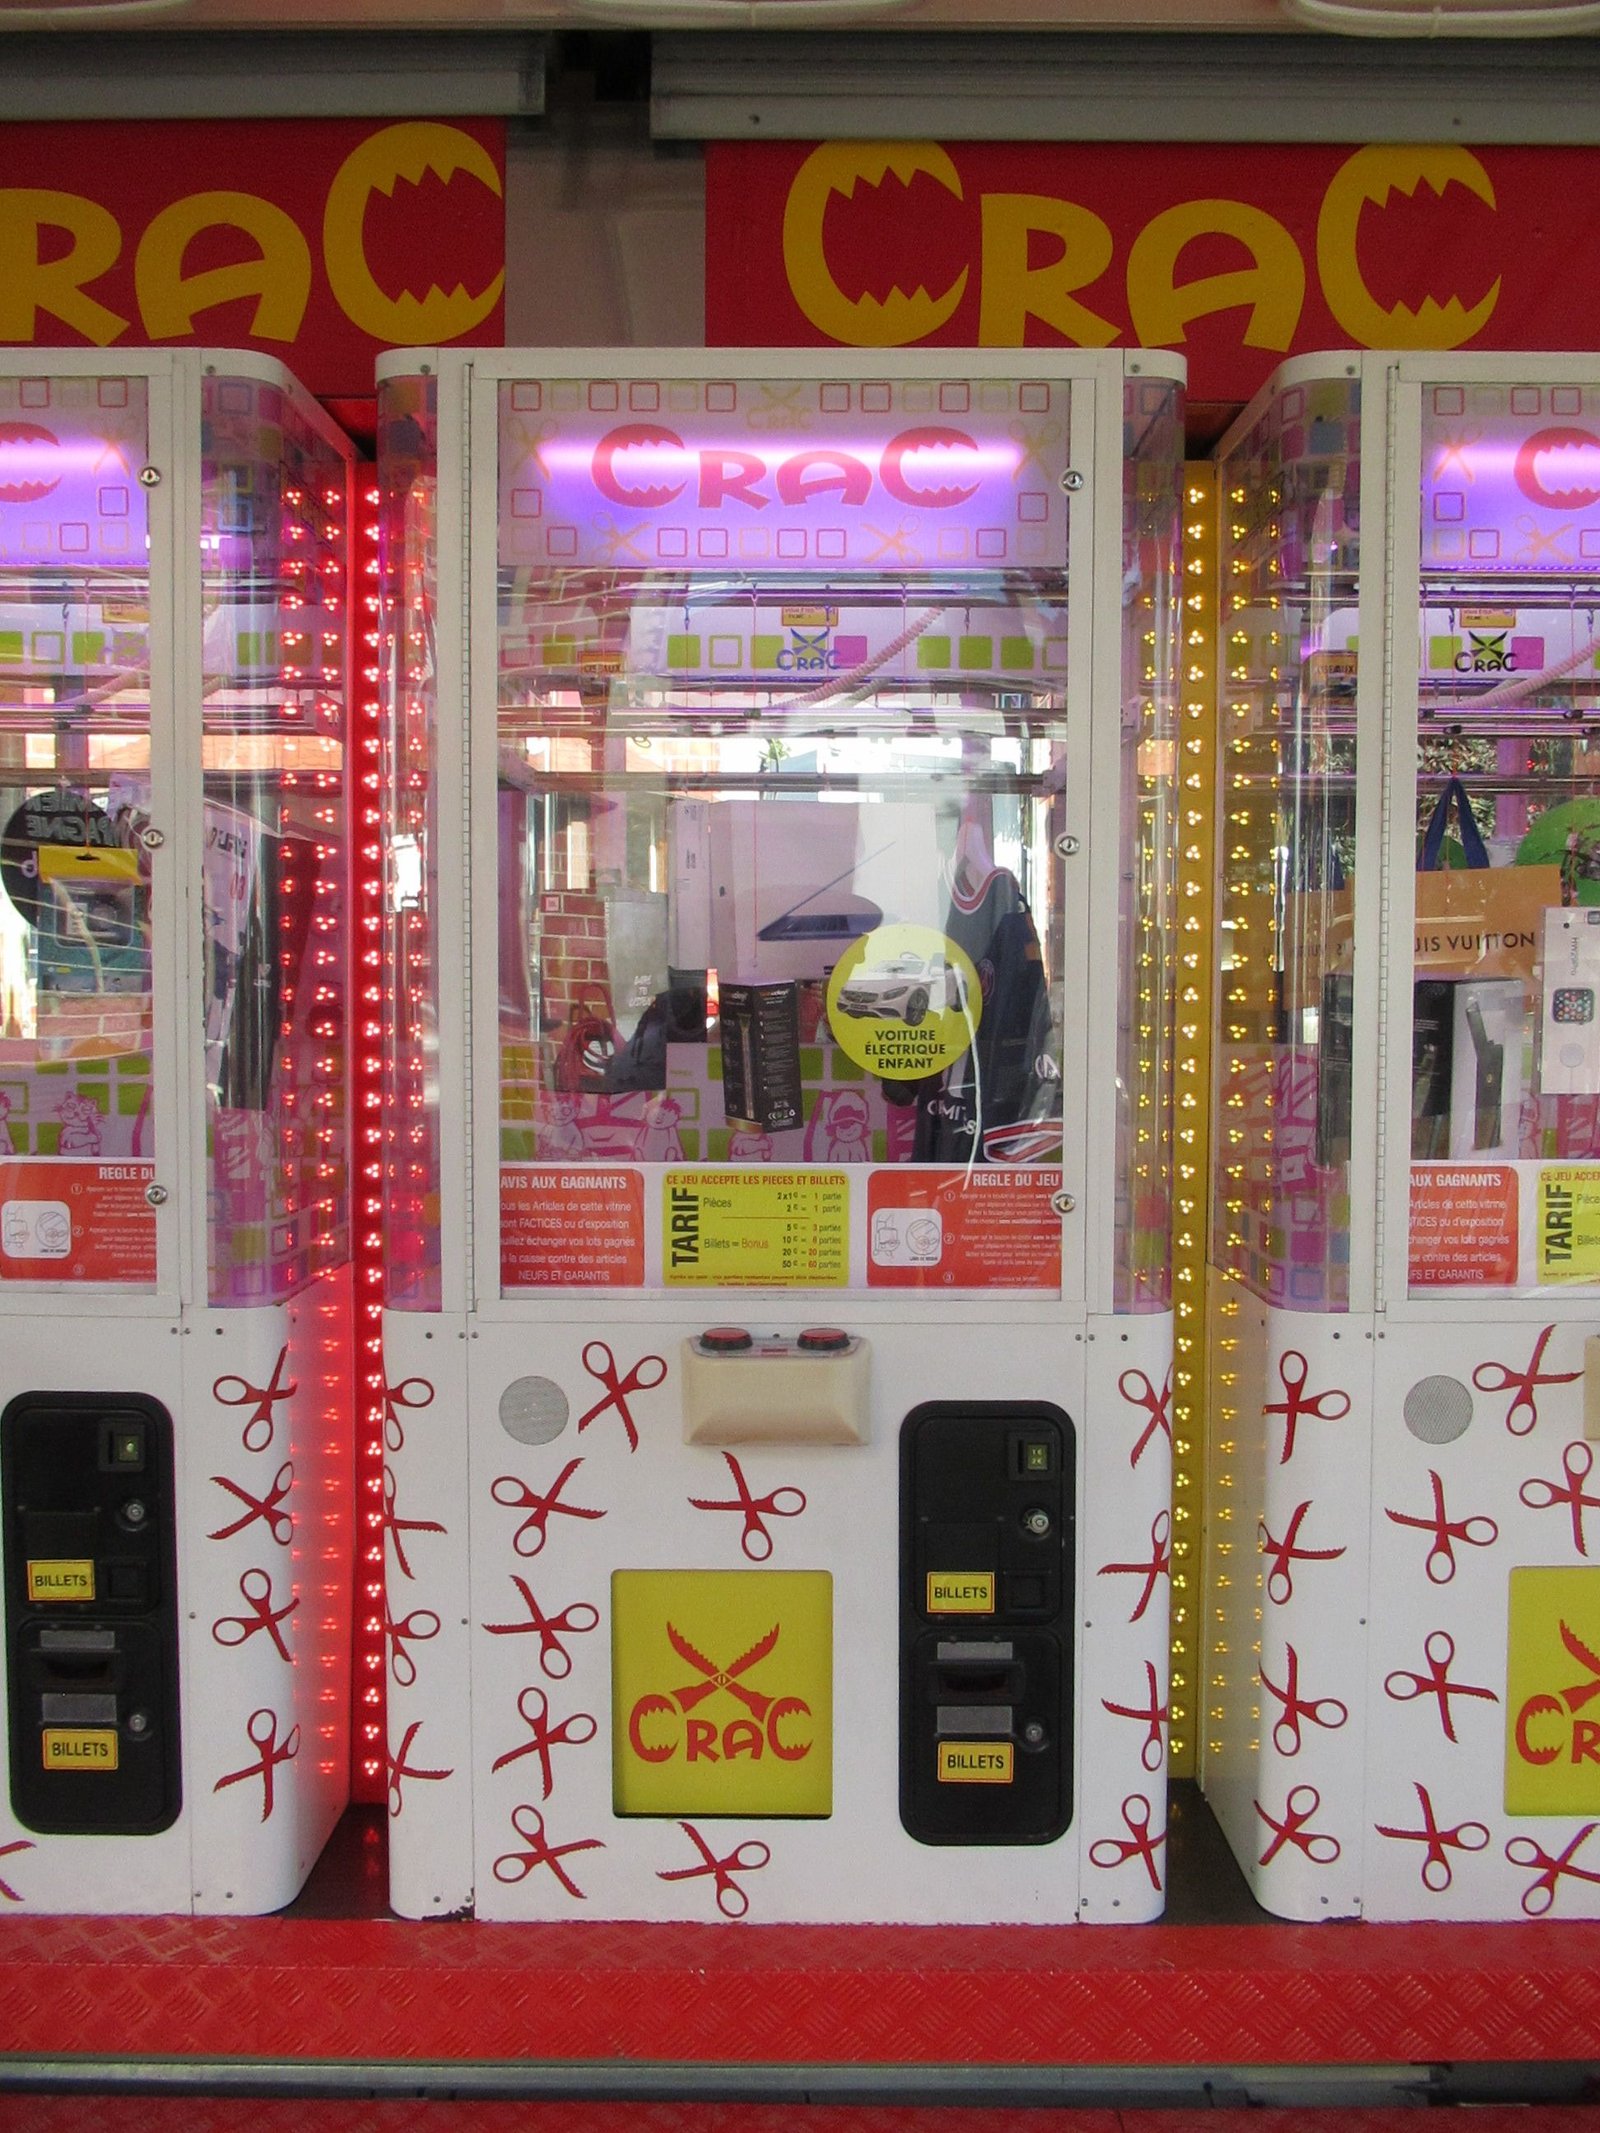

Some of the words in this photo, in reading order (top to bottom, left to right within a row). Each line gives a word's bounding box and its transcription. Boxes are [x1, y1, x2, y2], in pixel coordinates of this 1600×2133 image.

[783, 141, 1502, 352] CRAC
[591, 423, 984, 511] CRAC
[776, 649, 842, 671] CRAC
[1454, 651, 1518, 673] CRAC
[1447, 931, 1536, 951] VUITTON
[875, 1030, 936, 1041] VOITURE
[865, 1041, 946, 1055] ÉLECTRIQUE
[878, 1057, 933, 1069] ENFANT
[99, 1167, 137, 1180] REGLE
[973, 1173, 1011, 1187] REGLE
[1015, 1173, 1032, 1187] DU
[1036, 1173, 1059, 1187] JEU
[1541, 1172, 1552, 1181] CE
[1555, 1172, 1572, 1181] JEU
[501, 1176, 527, 1189] AVIS
[531, 1176, 557, 1189] AUX
[561, 1176, 627, 1189] GAGNANTS
[667, 1175, 678, 1185] CE
[681, 1175, 698, 1185] JEU
[701, 1175, 740, 1185] ACCEPTE
[743, 1175, 760, 1185] LES
[762, 1175, 794, 1185] PIECES
[796, 1175, 806, 1185] ET
[810, 1175, 846, 1186] BILLETS
[1437, 1174, 1501, 1187] GAGNANTS
[533, 1201, 564, 1211] Articles
[566, 1201, 579, 1211] de
[580, 1201, 603, 1211] cette
[703, 1196, 732, 1208] Pièces
[519, 1218, 562, 1229] FACTICES
[564, 1220, 576, 1229] ou
[671, 1187, 699, 1268] TARIF
[1545, 1184, 1573, 1265] TARIF
[704, 1238, 730, 1249] Billets
[741, 1238, 769, 1249] Bonus
[547, 1253, 576, 1263] contre
[578, 1253, 594, 1263] des
[595, 1253, 627, 1264] articles
[518, 1270, 549, 1280] NEUFS
[551, 1270, 561, 1280] ET
[563, 1270, 610, 1280] GARANTIS
[1425, 1269, 1435, 1280] ET
[1438, 1269, 1484, 1280] GARANTIS
[35, 1574, 87, 1587] BILLETS
[934, 1586, 988, 1599] BILLETS
[629, 1694, 813, 1763] CRAC
[52, 1742, 108, 1756] BILLETS
[947, 1753, 1005, 1769] BILLETS
